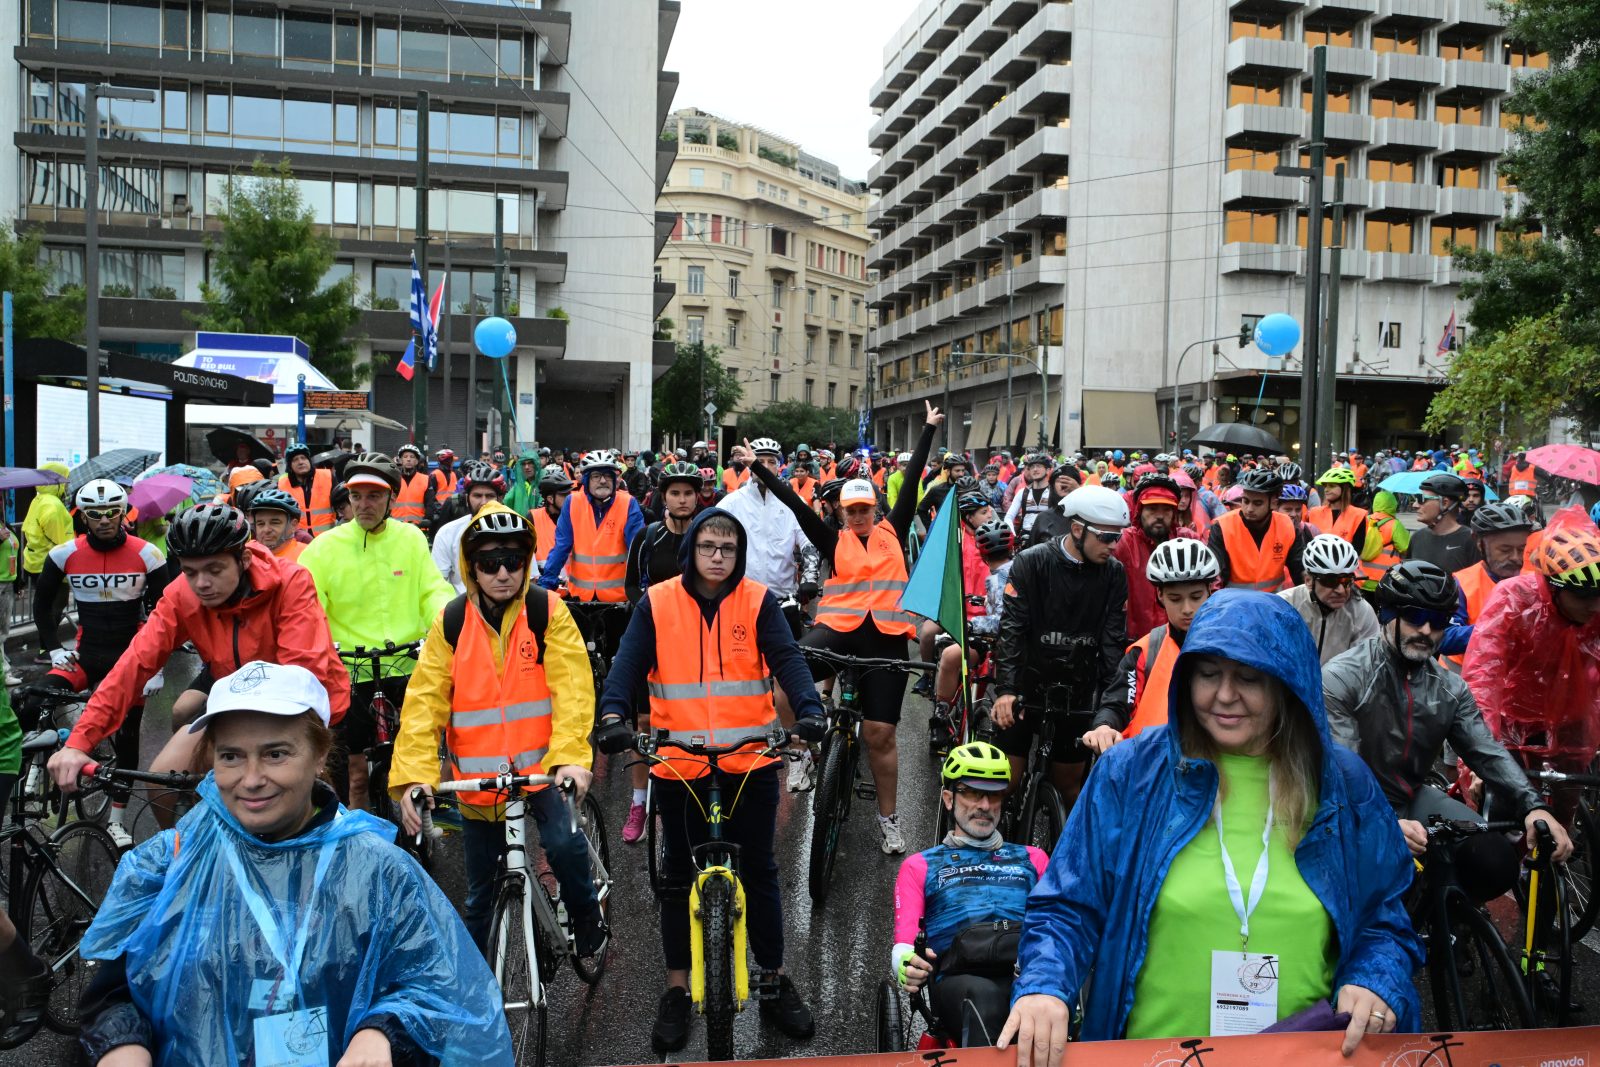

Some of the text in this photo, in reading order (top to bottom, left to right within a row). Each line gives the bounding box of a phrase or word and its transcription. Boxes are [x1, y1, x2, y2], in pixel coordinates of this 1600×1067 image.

[202, 356, 214, 364] TO
[200, 362, 237, 371] RED BULL
[173, 370, 228, 391] POLITIS SYNCHRO
[70, 574, 141, 589] EGYPT
[959, 863, 1024, 875] PROTASIS
